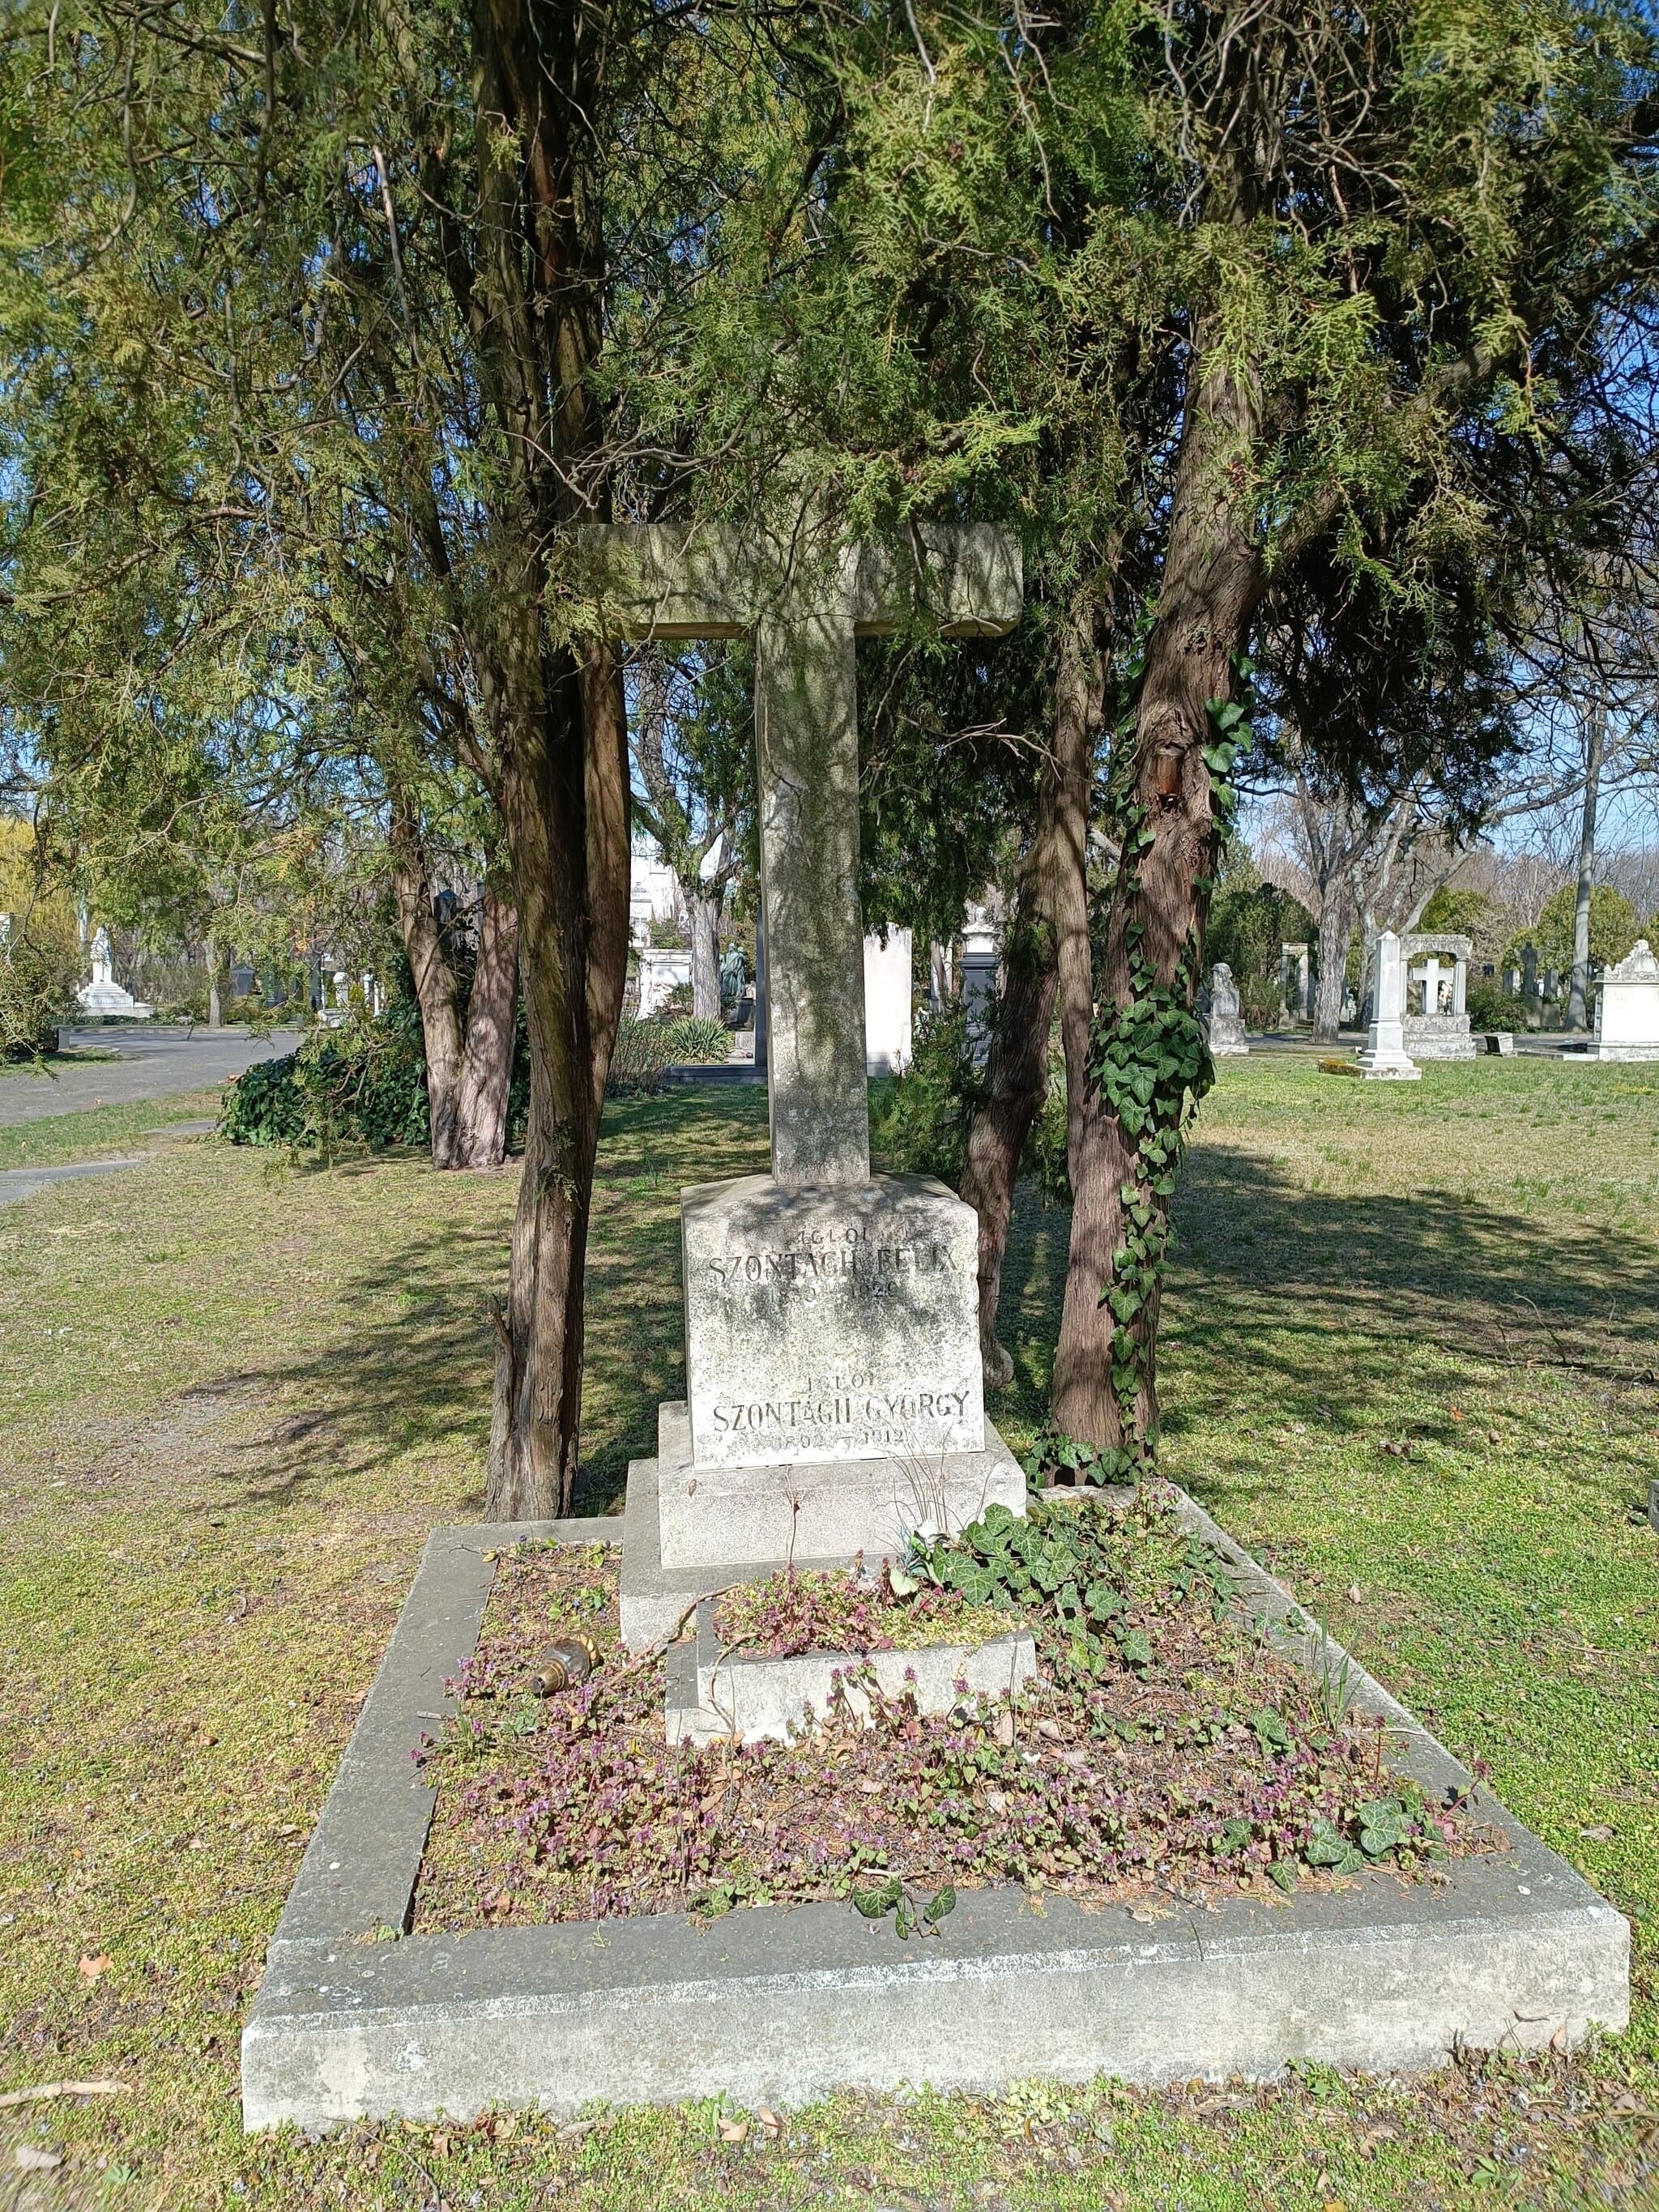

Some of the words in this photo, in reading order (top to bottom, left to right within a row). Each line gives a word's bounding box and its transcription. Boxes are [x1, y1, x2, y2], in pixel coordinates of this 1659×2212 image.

[709, 1248, 857, 1284] SZONTAGH
[713, 1397, 851, 1433] SZONTAGH
[865, 1386, 970, 1422] GYÖRGY
